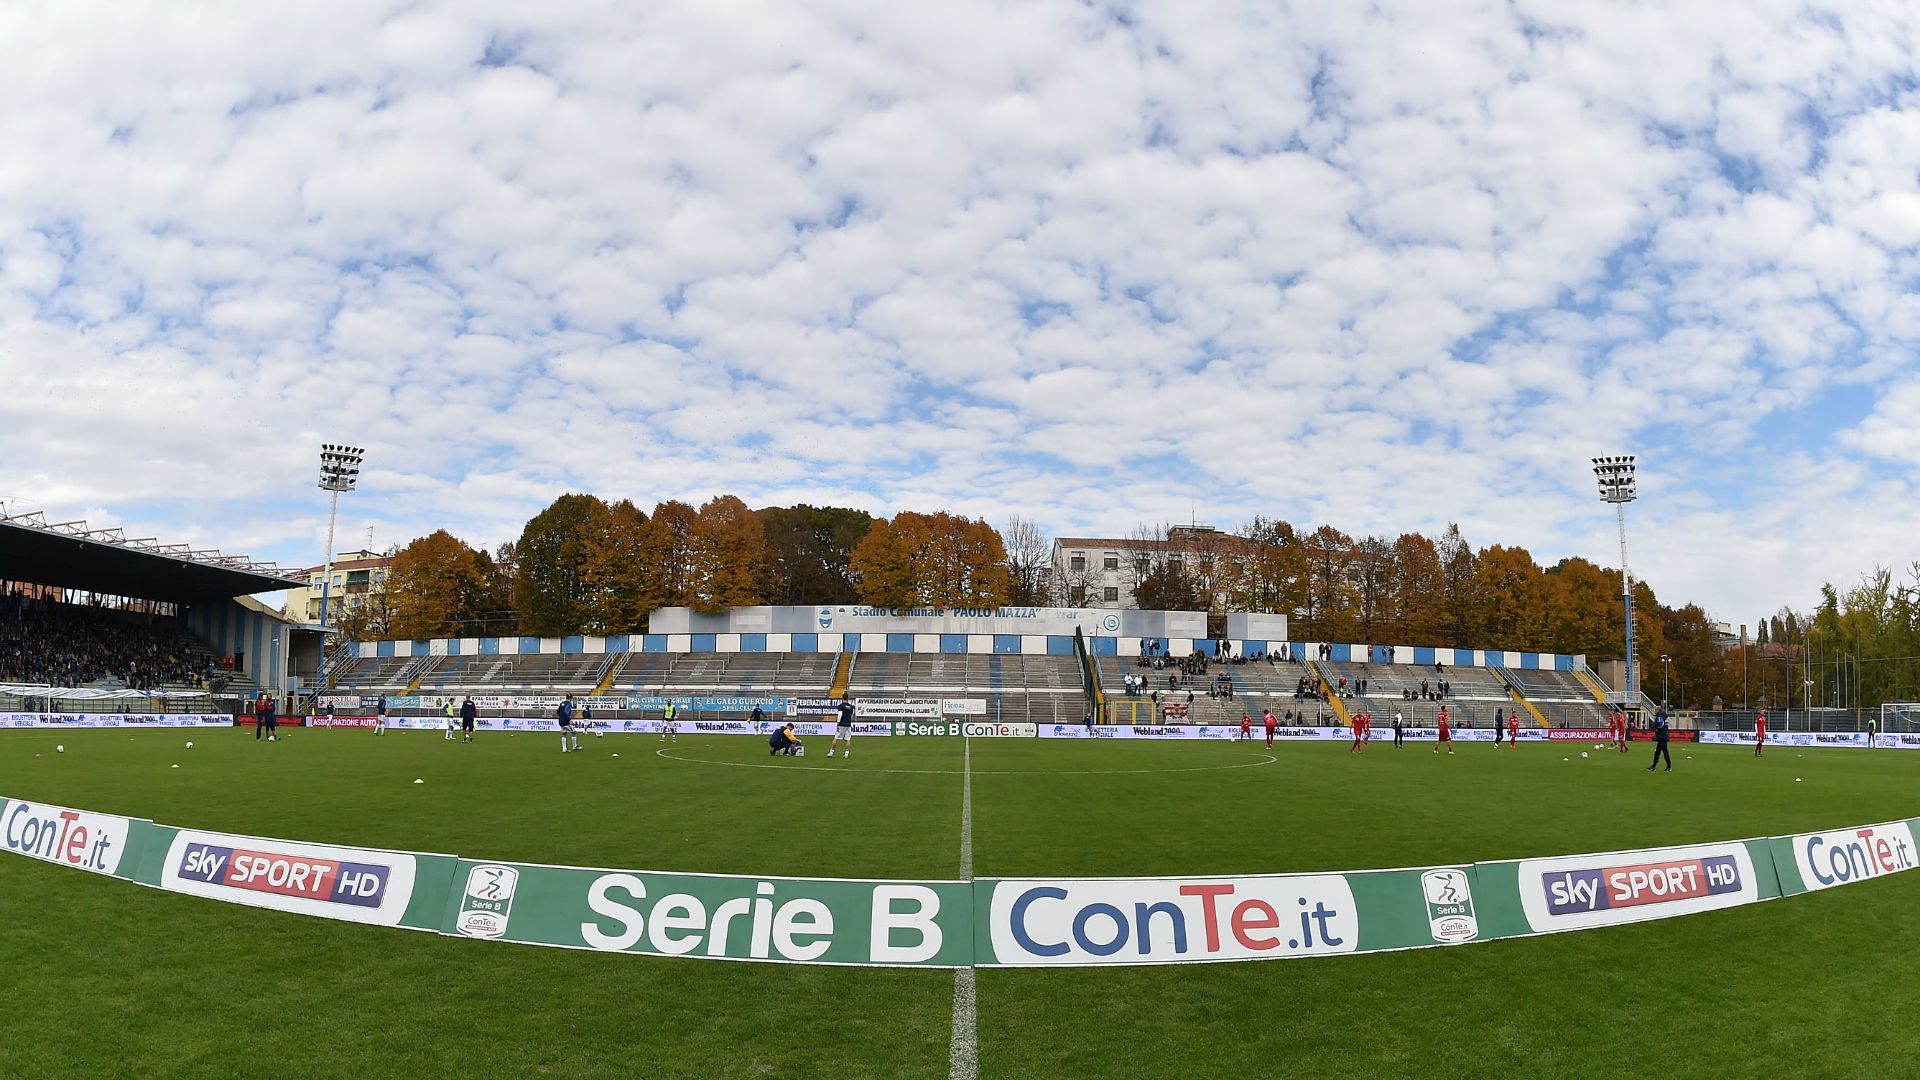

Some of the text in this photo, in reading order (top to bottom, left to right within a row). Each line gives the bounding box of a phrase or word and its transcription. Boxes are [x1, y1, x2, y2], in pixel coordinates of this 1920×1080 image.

[852, 606, 887, 617] Stadio
[360, 719, 377, 727] AUTO
[908, 722, 960, 736] Serie B
[965, 723, 1020, 737] ConTe.it
[1549, 731, 1601, 739] ASSICURAZIONE
[6, 803, 111, 871] ConTe.it
[1807, 829, 1912, 886] ConTe.it
[184, 848, 381, 898] sky SPORT HD
[1551, 862, 1737, 910] sky SPORT HD
[471, 900, 502, 911] Serie B
[1436, 905, 1466, 915] Serie B
[580, 872, 944, 963] Serie B
[1009, 883, 1345, 957] ConTe.it
